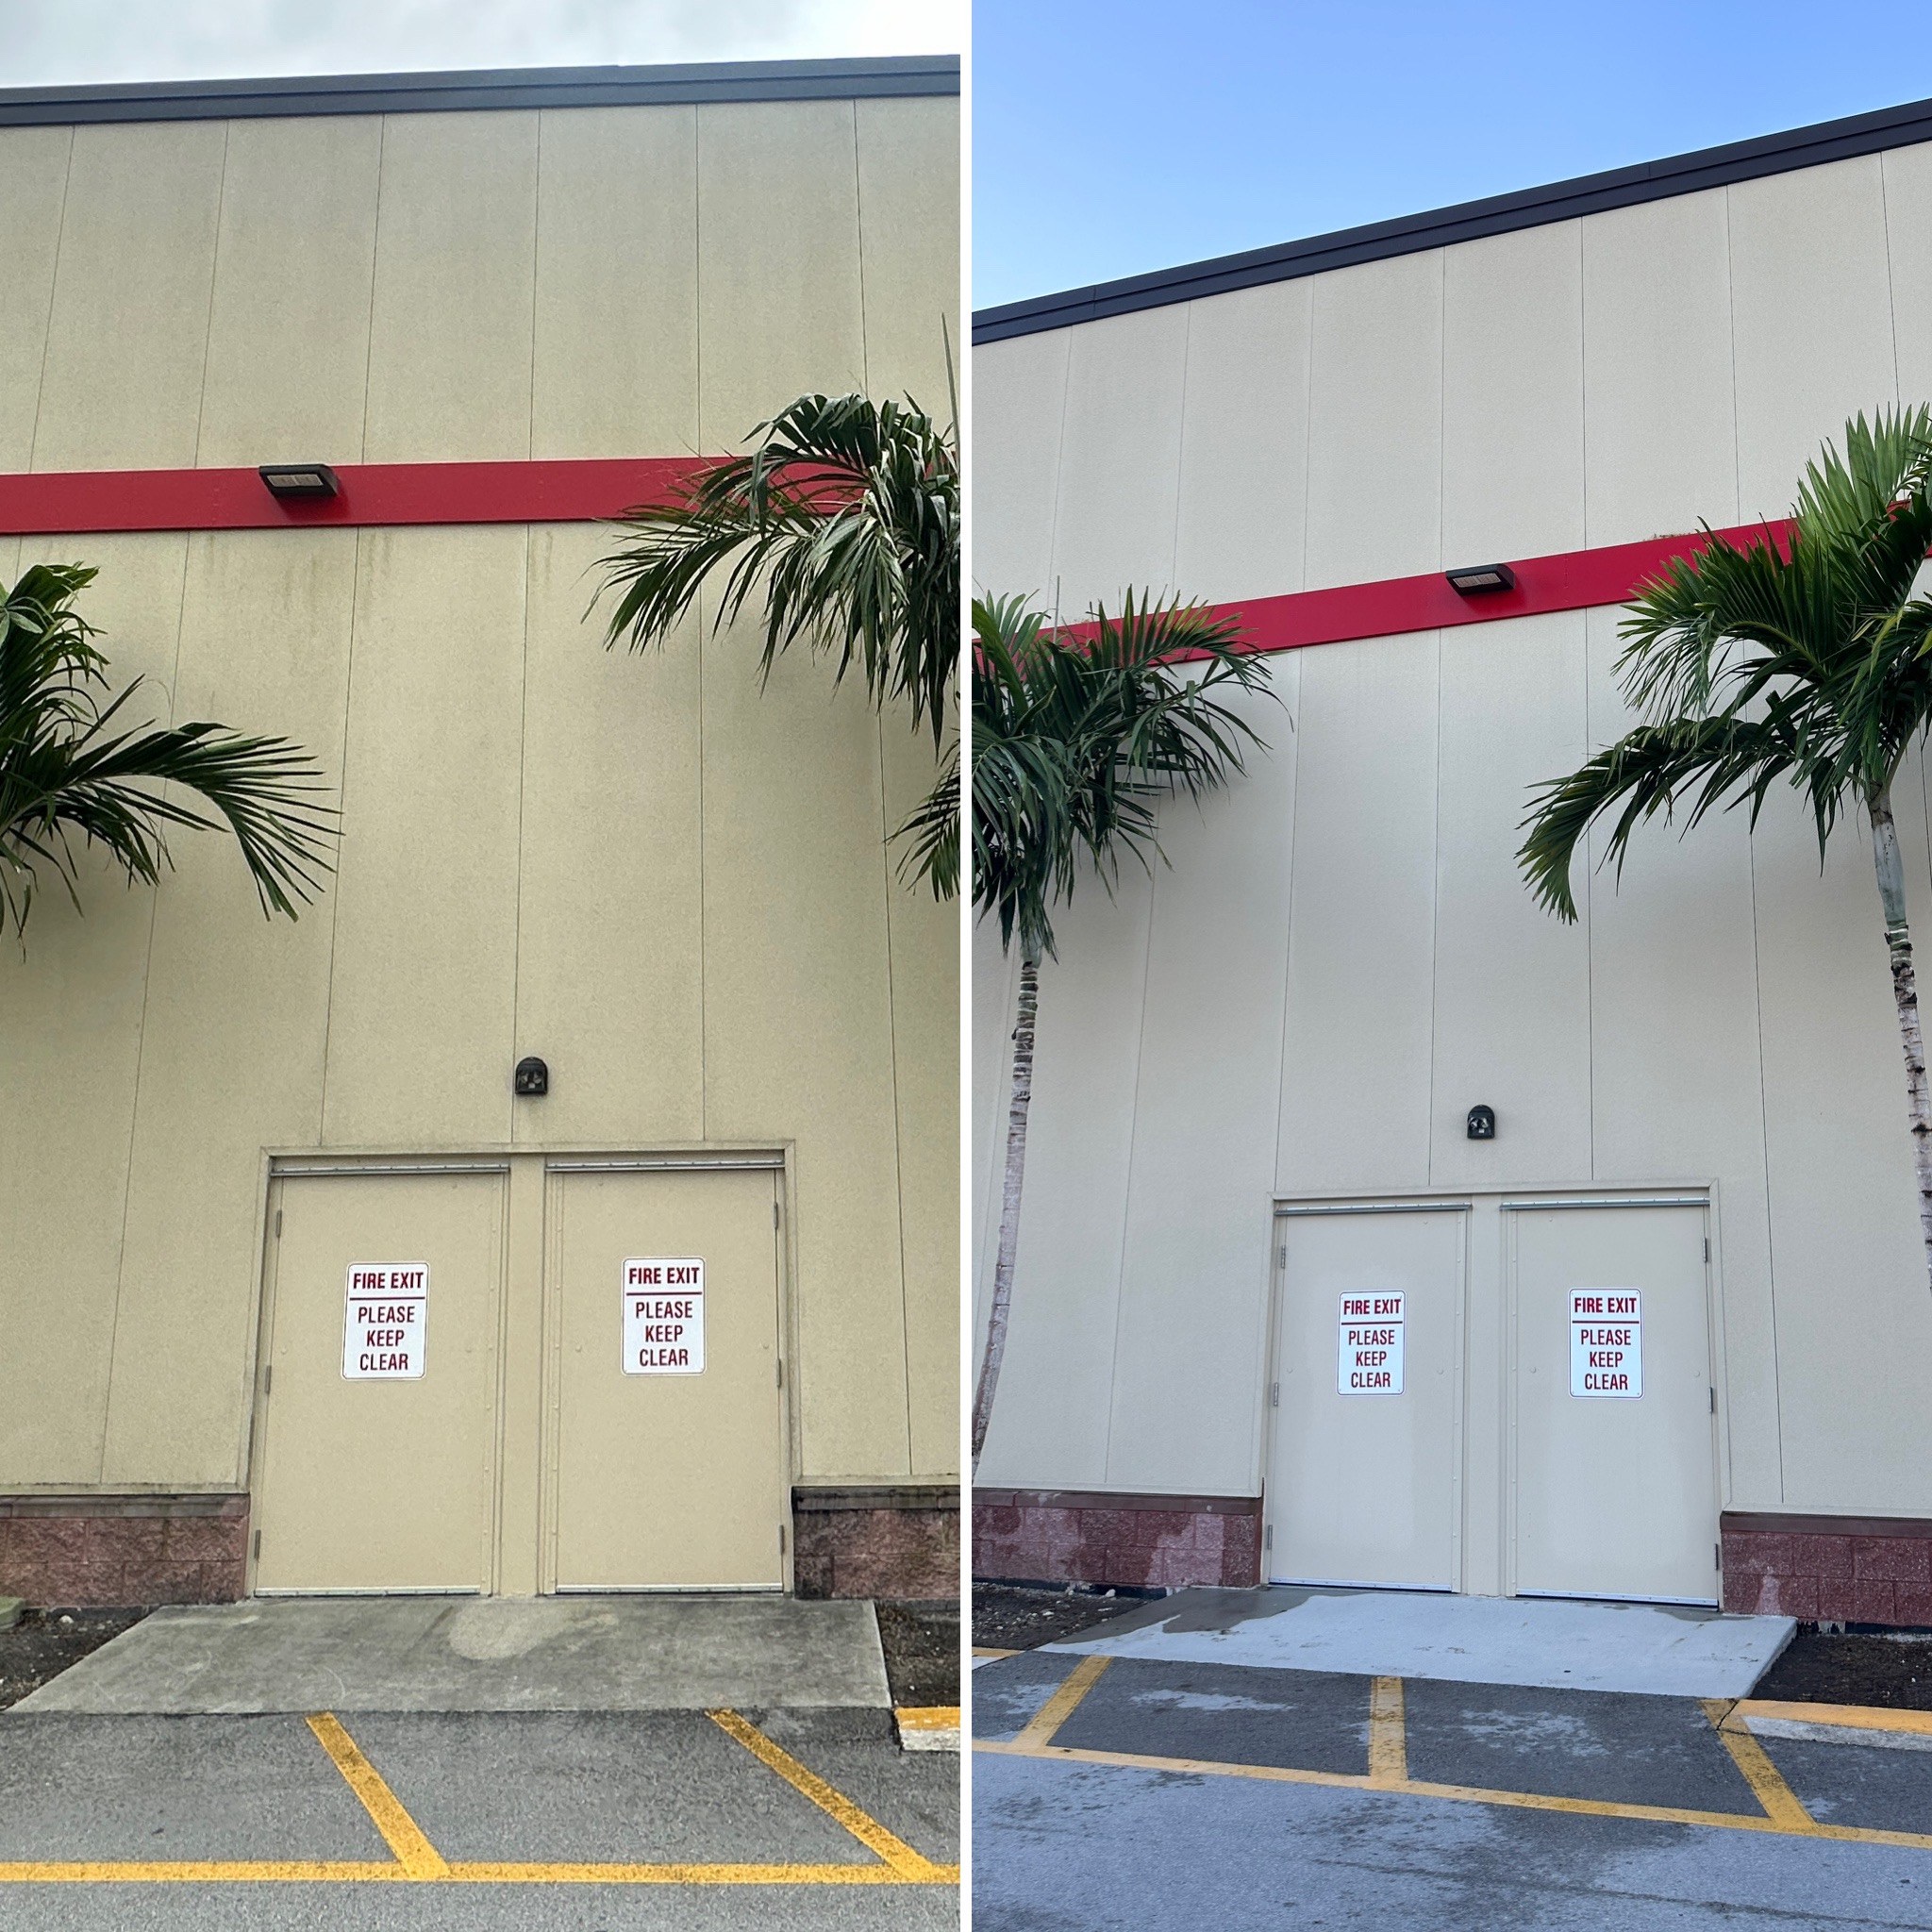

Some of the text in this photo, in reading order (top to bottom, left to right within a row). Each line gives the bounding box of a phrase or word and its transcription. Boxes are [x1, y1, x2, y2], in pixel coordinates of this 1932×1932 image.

[353, 1272, 424, 1289] FIRE EXIT
[628, 1267, 699, 1284] FIRE EXIT
[636, 1301, 692, 1319] PLEASE
[1343, 1299, 1401, 1315] FIRE EXIT
[1574, 1297, 1637, 1313] FIRE EXIT
[358, 1306, 415, 1324] PLEASE
[366, 1329, 405, 1346] KEEP
[645, 1324, 683, 1342] KEEP
[1348, 1330, 1394, 1345] PLEASE
[1581, 1329, 1631, 1345] PLEASE
[359, 1353, 408, 1371] CLEAR
[640, 1348, 688, 1366] CLEAR
[1356, 1351, 1387, 1366] KEEP
[1590, 1351, 1623, 1367] KEEP
[1351, 1372, 1391, 1388] CLEAR
[1585, 1374, 1628, 1390] CLEAR
